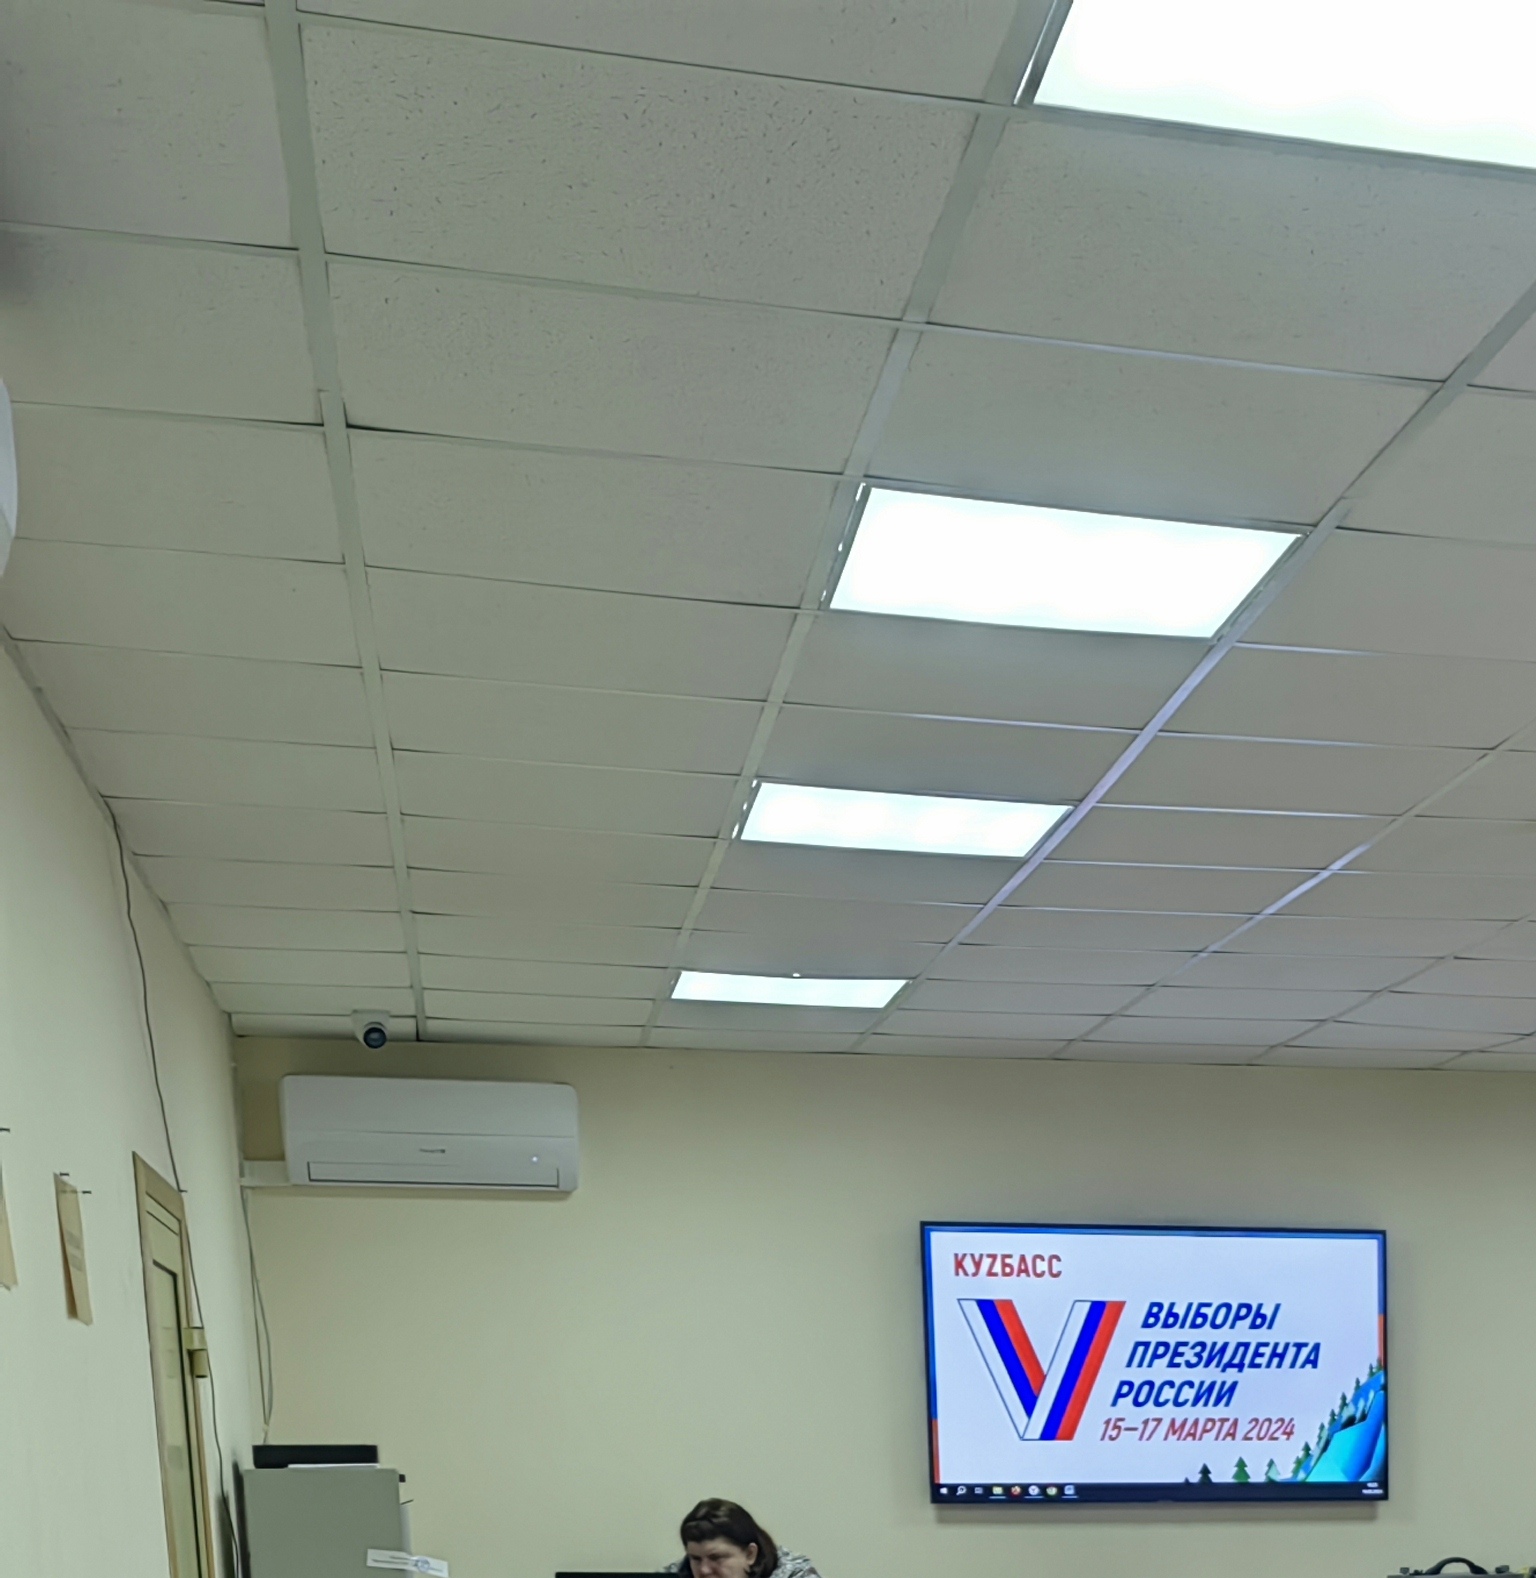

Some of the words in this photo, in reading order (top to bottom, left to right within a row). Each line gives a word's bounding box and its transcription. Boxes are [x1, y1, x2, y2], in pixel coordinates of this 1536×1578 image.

[1140, 1301, 1281, 1330] ВЫБОРЫ
[1125, 1341, 1321, 1373] ПРЕЗИДЕНТА
[1110, 1380, 1239, 1408] РОССИИ
[1163, 1417, 1239, 1441] МАРТА
[1241, 1417, 1296, 1441] 2024
